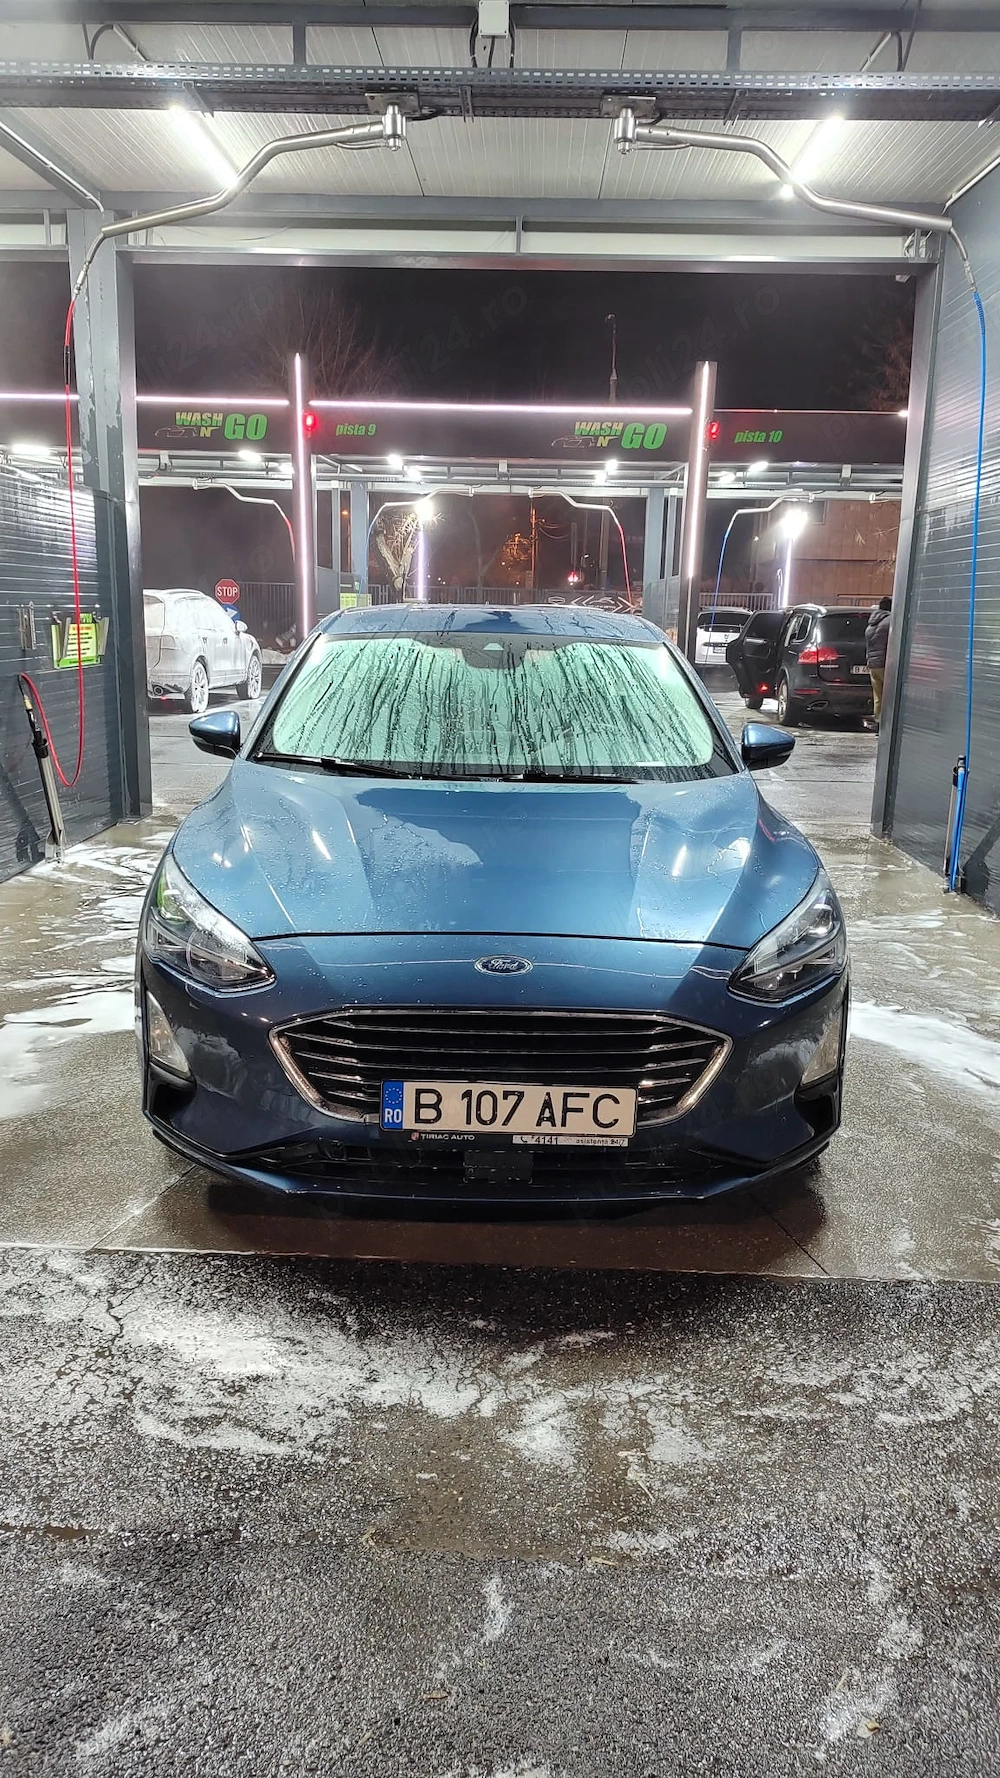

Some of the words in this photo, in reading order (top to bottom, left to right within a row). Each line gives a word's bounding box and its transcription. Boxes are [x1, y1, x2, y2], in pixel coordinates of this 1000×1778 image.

[175, 411, 223, 427] WASH
[224, 413, 268, 441] GO
[335, 422, 366, 437] pista
[367, 423, 377, 436] 9
[574, 421, 624, 436] WASH
[621, 422, 668, 450] GO
[734, 430, 766, 444] pista
[767, 430, 783, 443] 10
[217, 586, 238, 598] STOP
[487, 958, 519, 970] Ford
[384, 1108, 402, 1124] RO
[414, 1088, 443, 1125] B
[461, 1089, 526, 1127] 107
[536, 1092, 621, 1129] AFC
